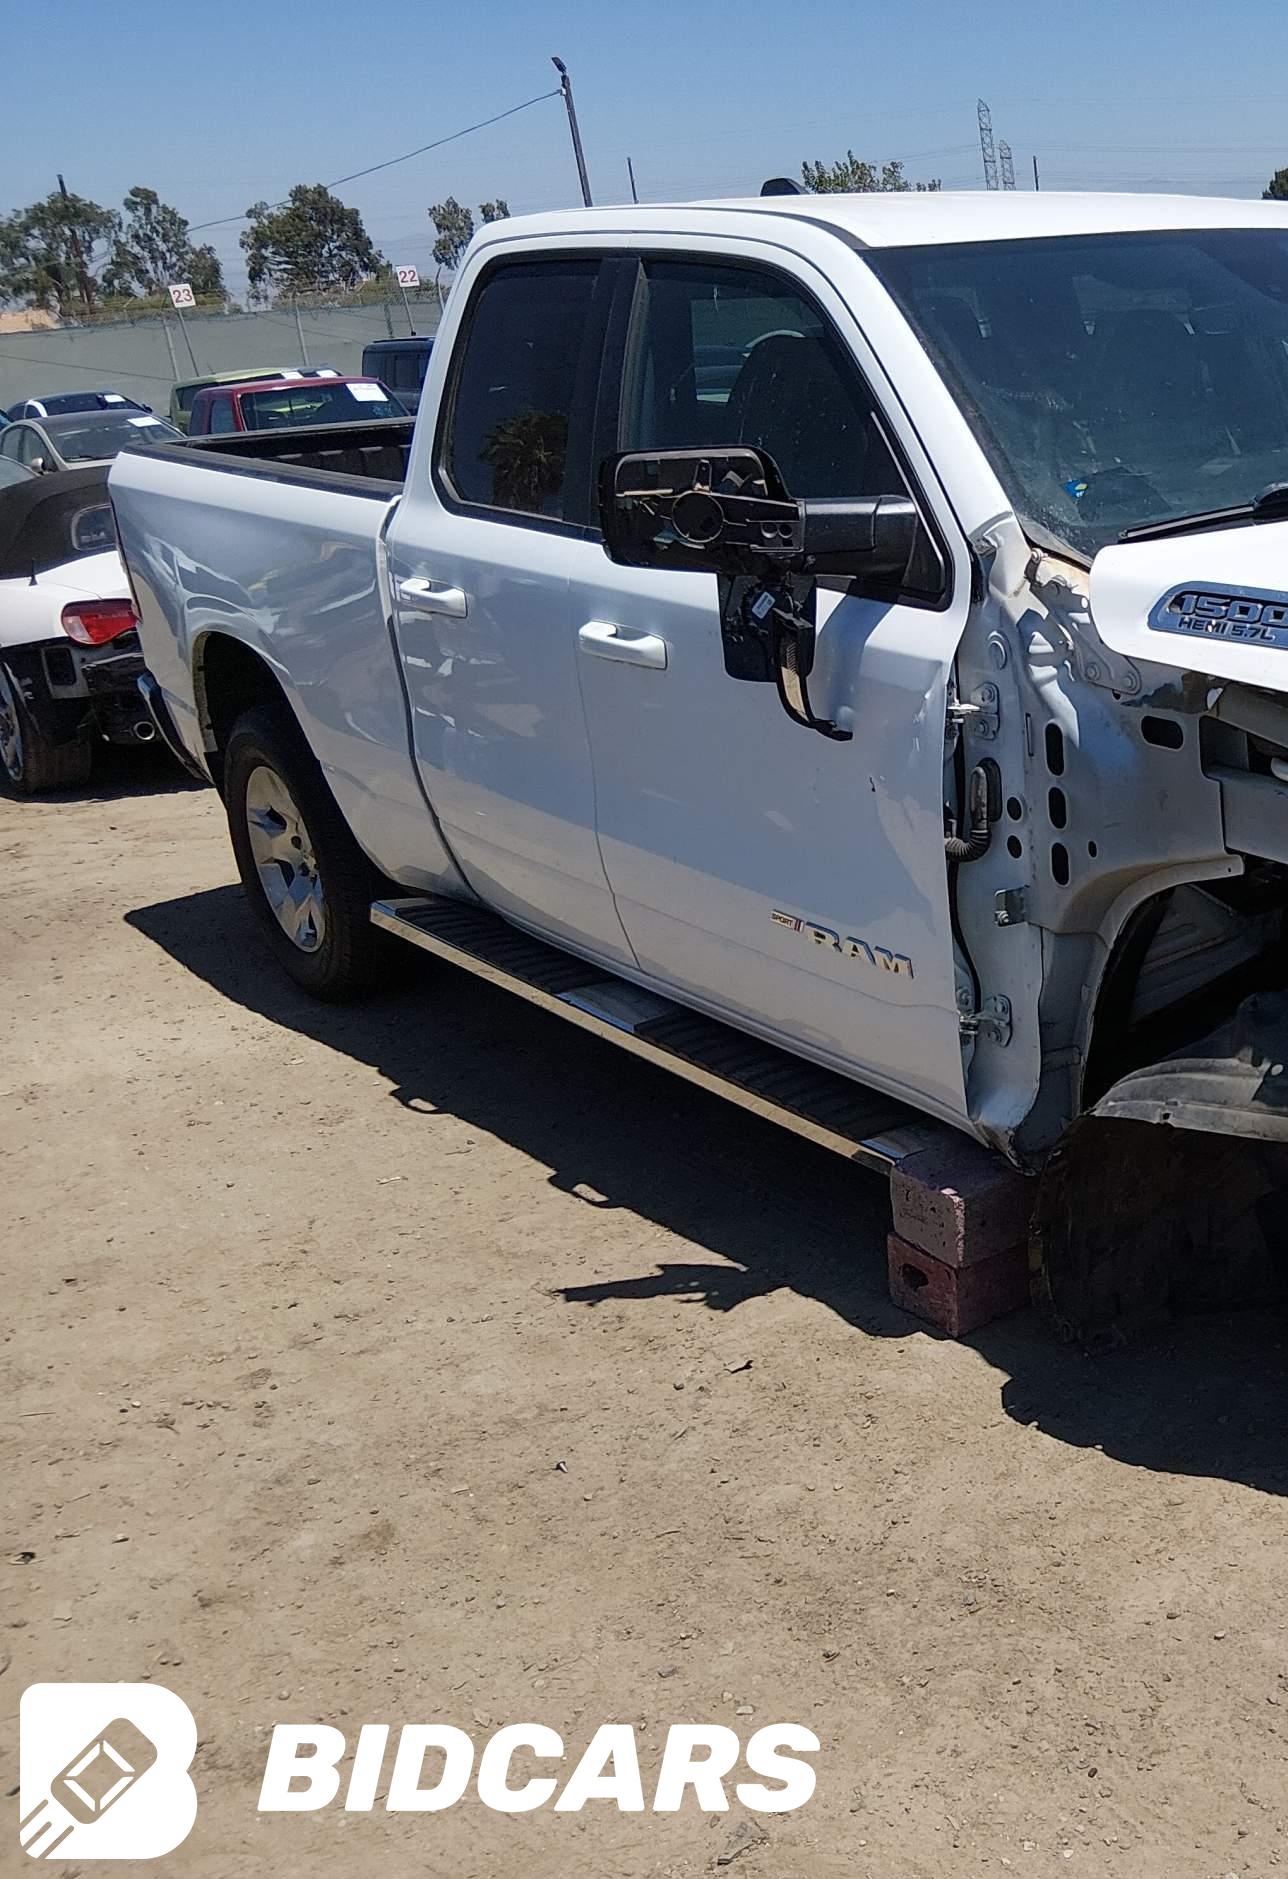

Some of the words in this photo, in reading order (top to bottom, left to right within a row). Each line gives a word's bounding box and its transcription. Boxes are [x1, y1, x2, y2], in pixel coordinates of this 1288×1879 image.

[399, 269, 418, 283] 22
[173, 289, 192, 303] 23
[1178, 617, 1227, 634] HEMI
[1231, 625, 1275, 641] 5.7L
[772, 912, 794, 927] SPORT
[803, 921, 915, 979] RAM
